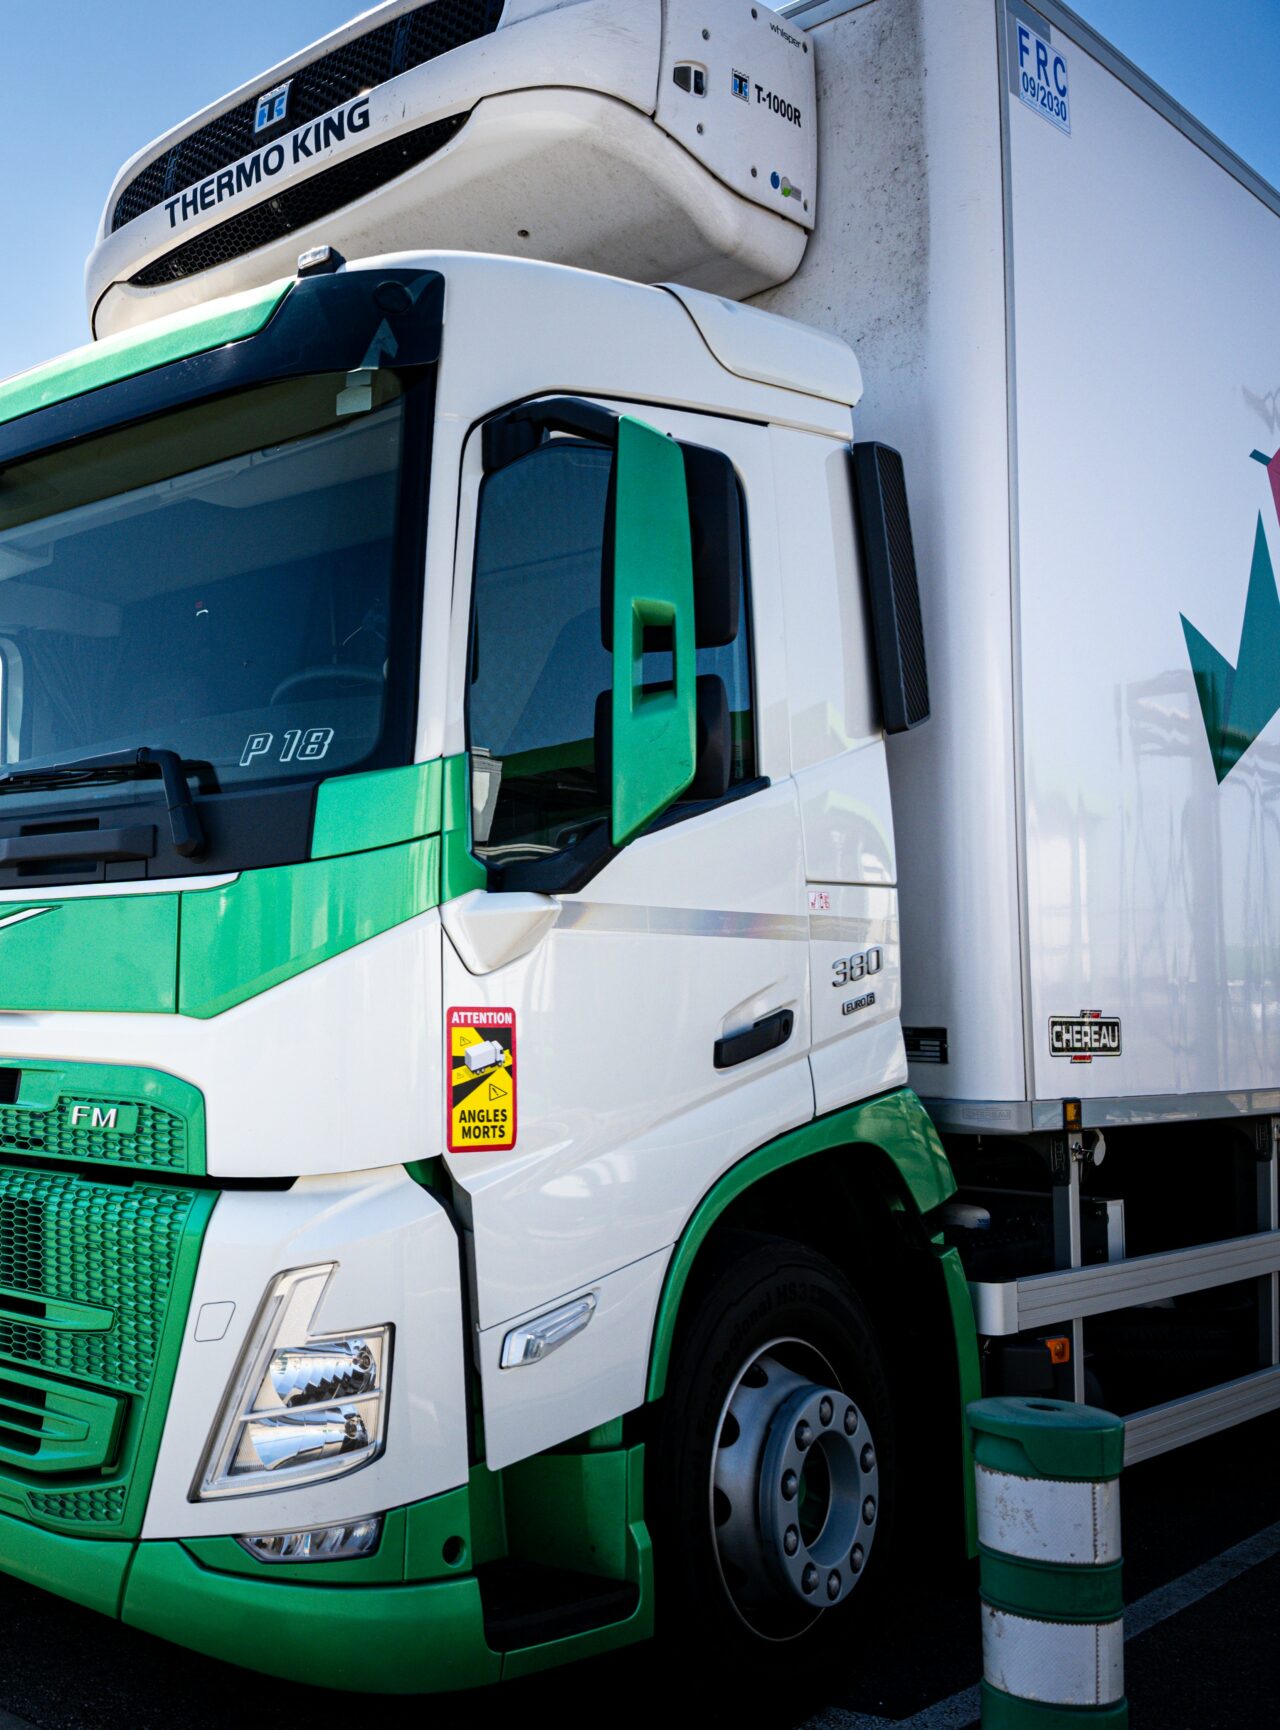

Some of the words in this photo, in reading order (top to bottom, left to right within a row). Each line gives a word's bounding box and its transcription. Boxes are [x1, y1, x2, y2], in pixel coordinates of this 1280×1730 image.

[769, 22, 801, 48] whisper
[1017, 25, 1067, 98] FRC
[754, 83, 802, 128] T-1000R
[1021, 71, 1067, 121] 09/2030
[164, 143, 285, 229] THERMO
[292, 97, 370, 165] KING
[240, 732, 274, 767] P
[280, 727, 335, 763] 18
[832, 945, 884, 988] 380
[451, 1011, 513, 1025] ATTENTION
[846, 997, 866, 1014] EURO
[1052, 1025, 1119, 1048] CHEREAU
[71, 1105, 118, 1128] FM
[459, 1109, 508, 1124] ANGLES
[461, 1125, 506, 1139] MORTS
